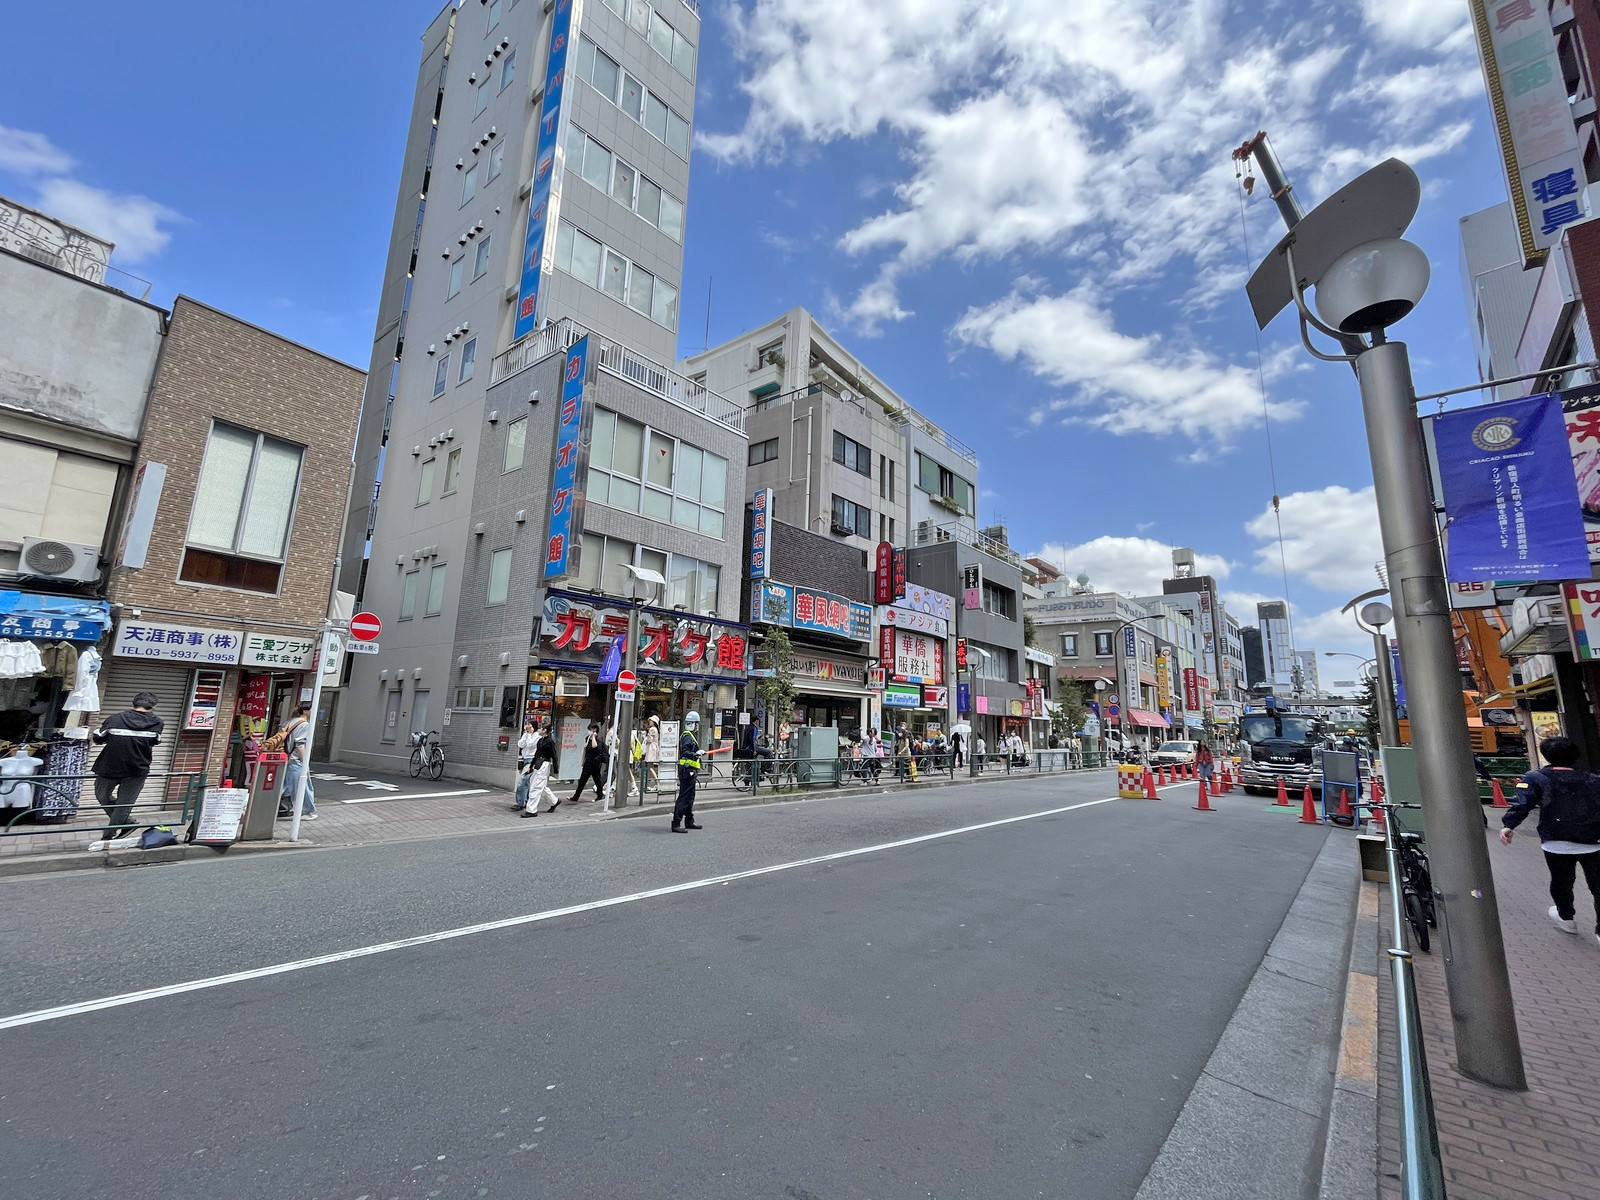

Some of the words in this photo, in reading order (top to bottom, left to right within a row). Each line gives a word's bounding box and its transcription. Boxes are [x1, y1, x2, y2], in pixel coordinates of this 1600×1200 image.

[1531, 168, 1585, 236] 寝具
[547, 355, 581, 563] カラオケ館
[1469, 456, 1501, 465] CRIACAO
[1502, 451, 1535, 460] SHINJUKU
[753, 493, 766, 569] 華風網吧
[796, 592, 850, 632] 華風網吧
[2, 627, 75, 639] 66-5555
[124, 626, 239, 649] 天涯商事(株)
[248, 637, 313, 654] 三愛プラザ
[326, 634, 339, 667] 動産
[902, 634, 927, 658] 華僑
[255, 653, 303, 665] 株式会社
[899, 655, 931, 677] 服務社
[893, 694, 919, 705] FamilyMart
